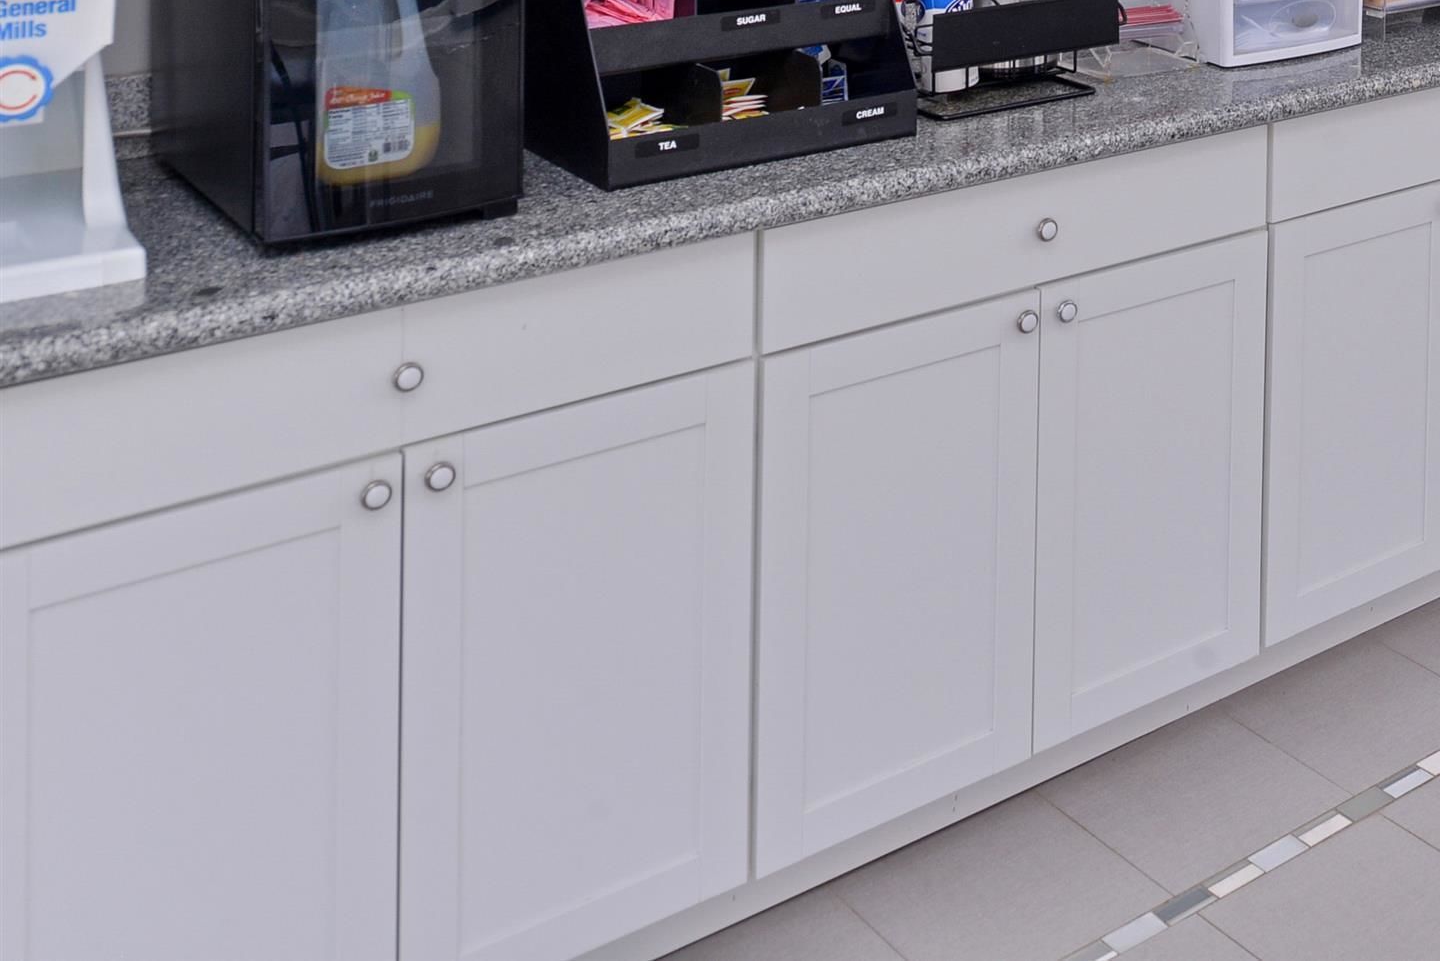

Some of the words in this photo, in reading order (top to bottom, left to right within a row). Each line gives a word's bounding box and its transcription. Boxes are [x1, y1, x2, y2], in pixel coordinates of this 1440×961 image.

[834, 3, 862, 14] EQUAL
[736, 14, 766, 26] SUGAR
[856, 106, 885, 120] CREAM
[658, 140, 677, 151] TEA
